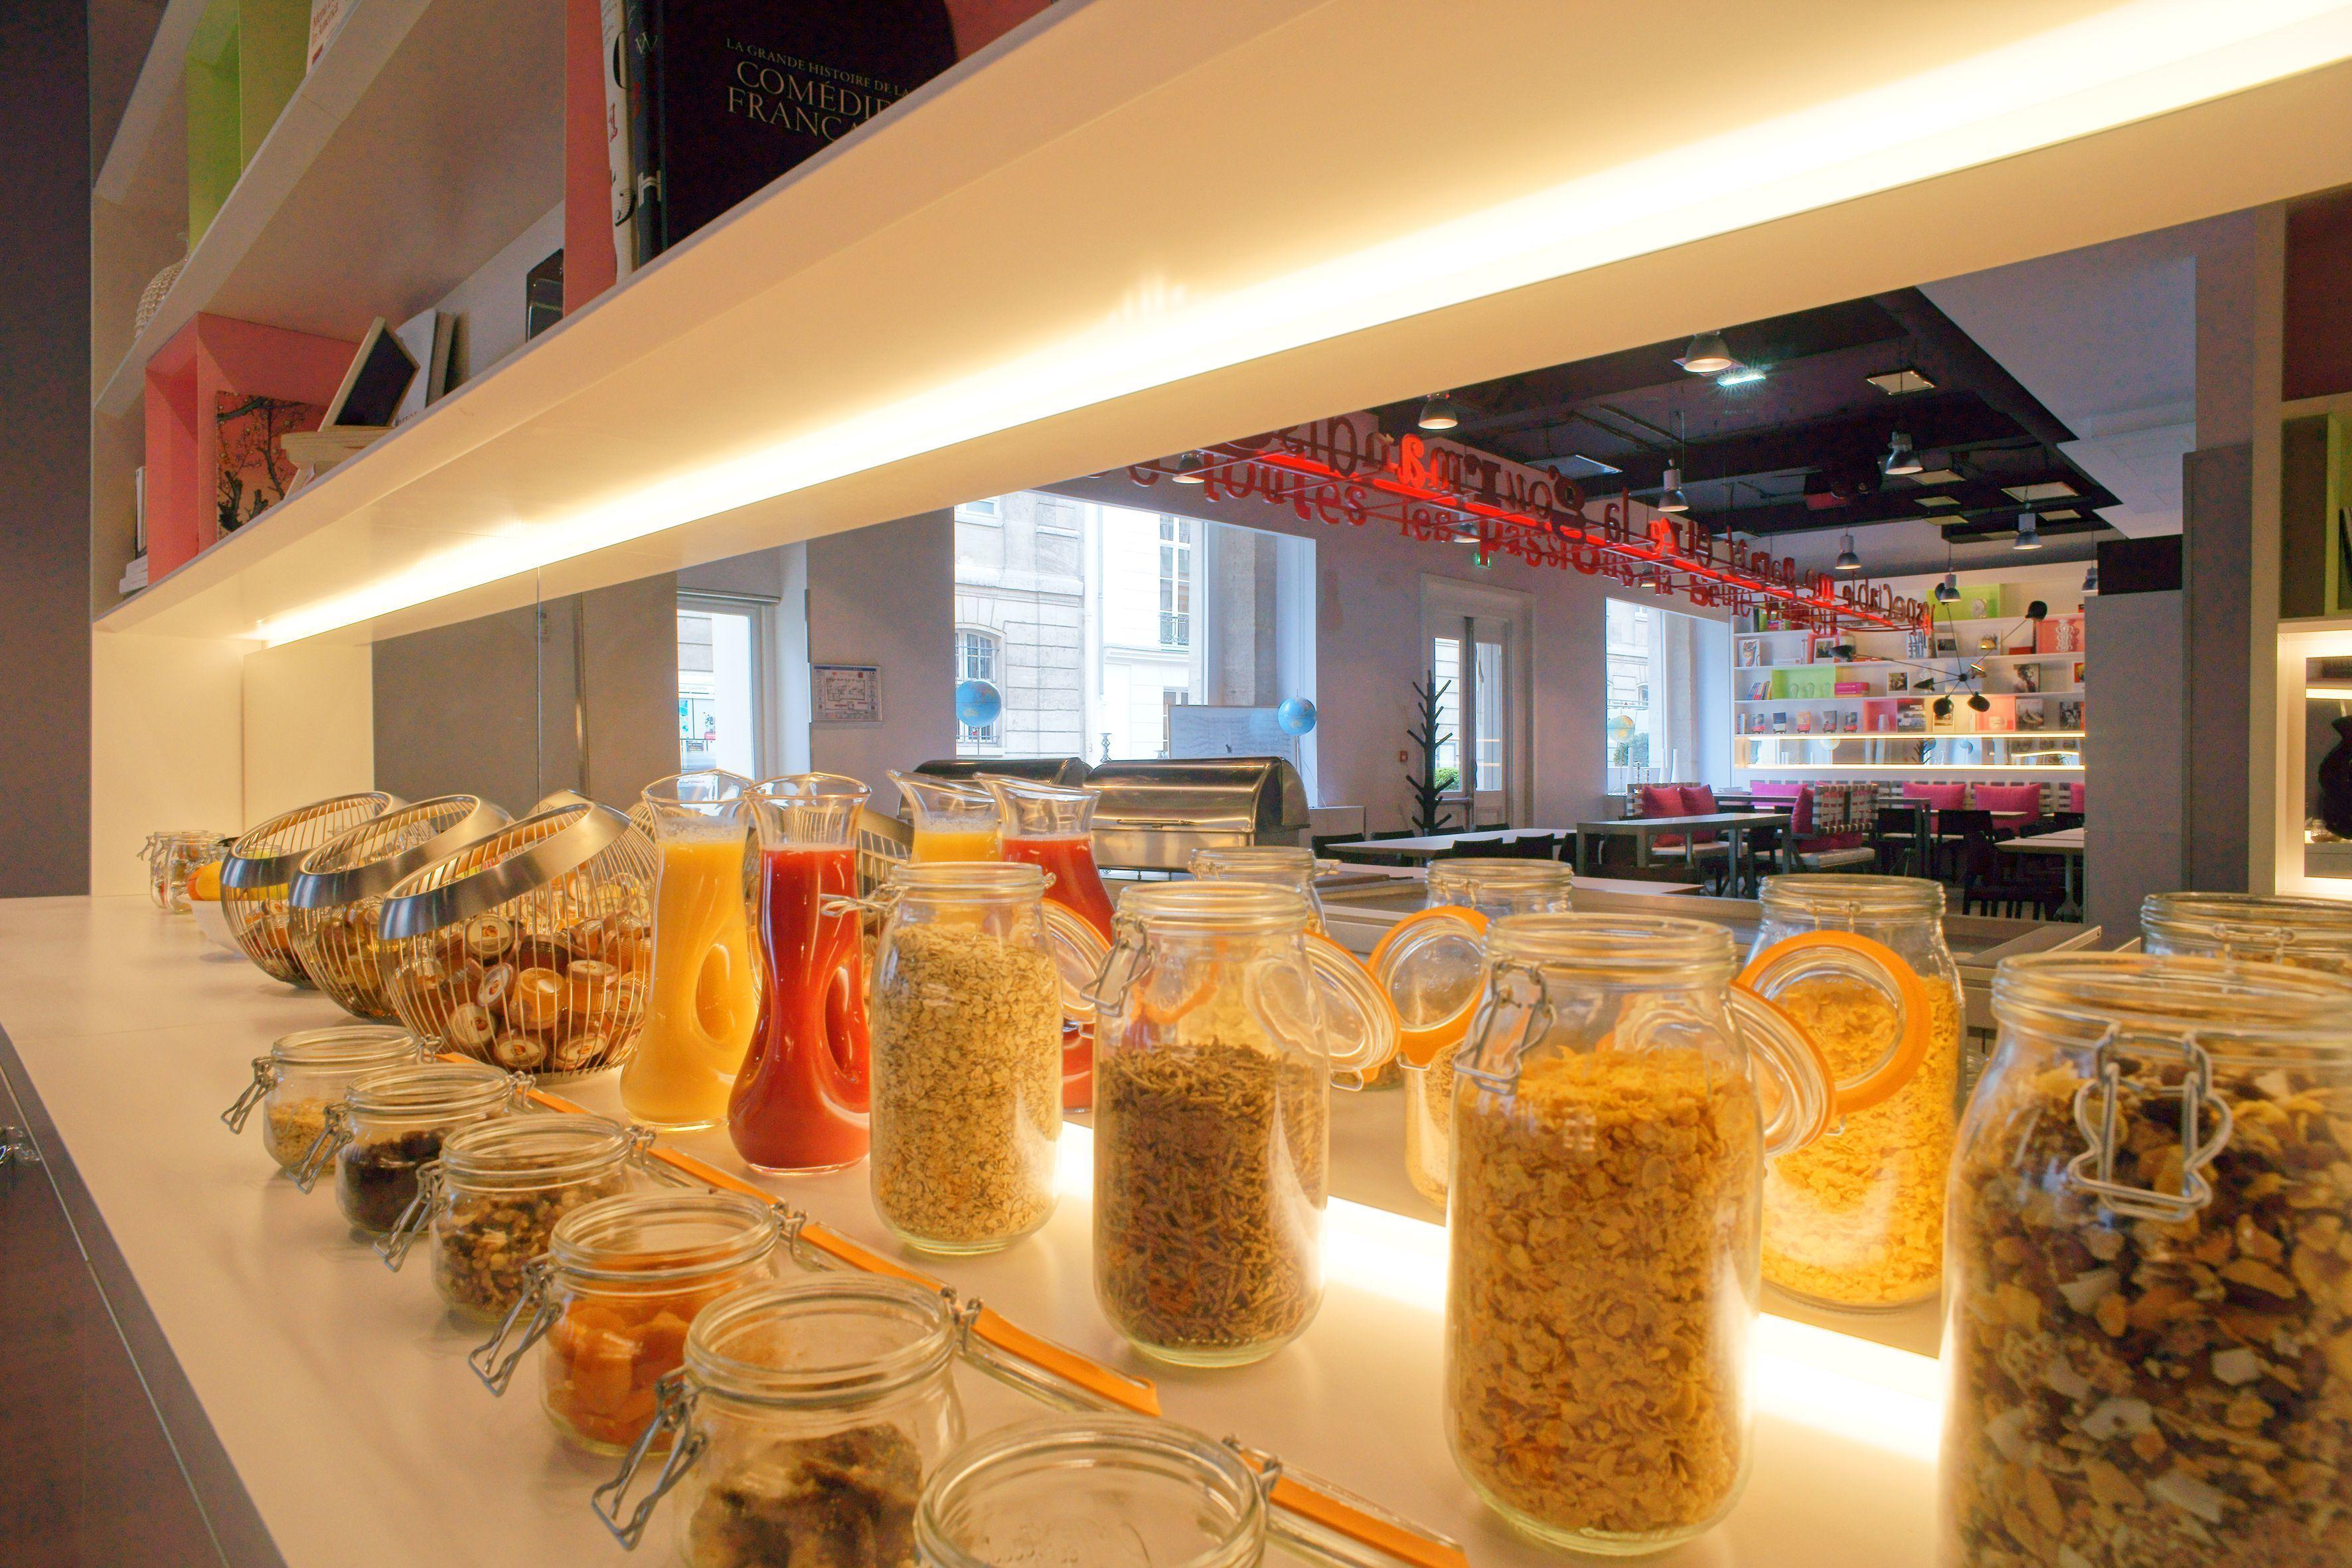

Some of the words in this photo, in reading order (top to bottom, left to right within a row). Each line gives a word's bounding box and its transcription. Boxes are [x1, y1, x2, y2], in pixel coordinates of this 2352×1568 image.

[727, 38, 744, 52] LA
[747, 44, 805, 70] GRANDE
[809, 62, 870, 88] HISTOIRE
[875, 80, 891, 94] DE
[895, 85, 909, 97] LA
[1203, 453, 1368, 526] toutes
[1399, 497, 1452, 542] les
[1654, 562, 1674, 595] la
